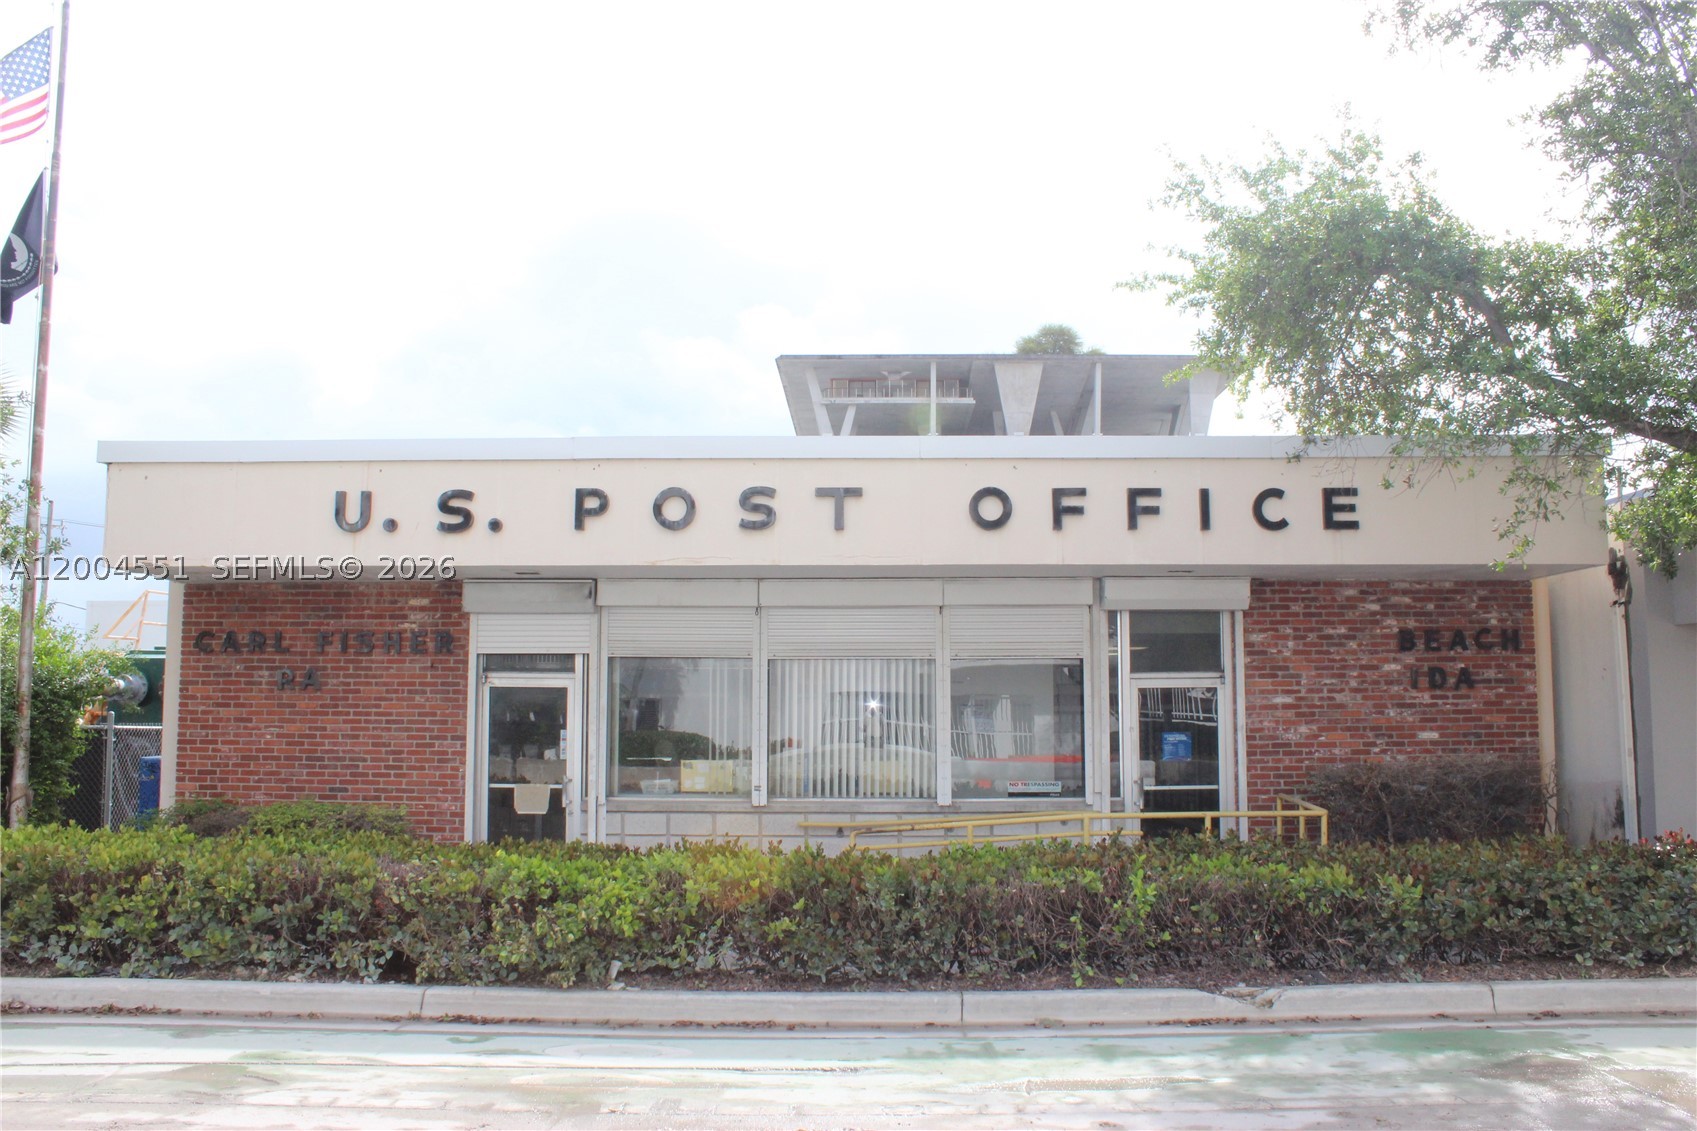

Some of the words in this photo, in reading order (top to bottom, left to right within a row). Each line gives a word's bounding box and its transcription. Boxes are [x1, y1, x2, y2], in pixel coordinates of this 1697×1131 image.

[573, 486, 864, 532] POST
[968, 487, 1361, 531] OFFICE
[193, 631, 289, 653] CARL
[316, 631, 455, 654] FISHER
[1398, 628, 1520, 651] BEACH
[276, 667, 322, 691] RA
[1411, 666, 1474, 690] IDA
